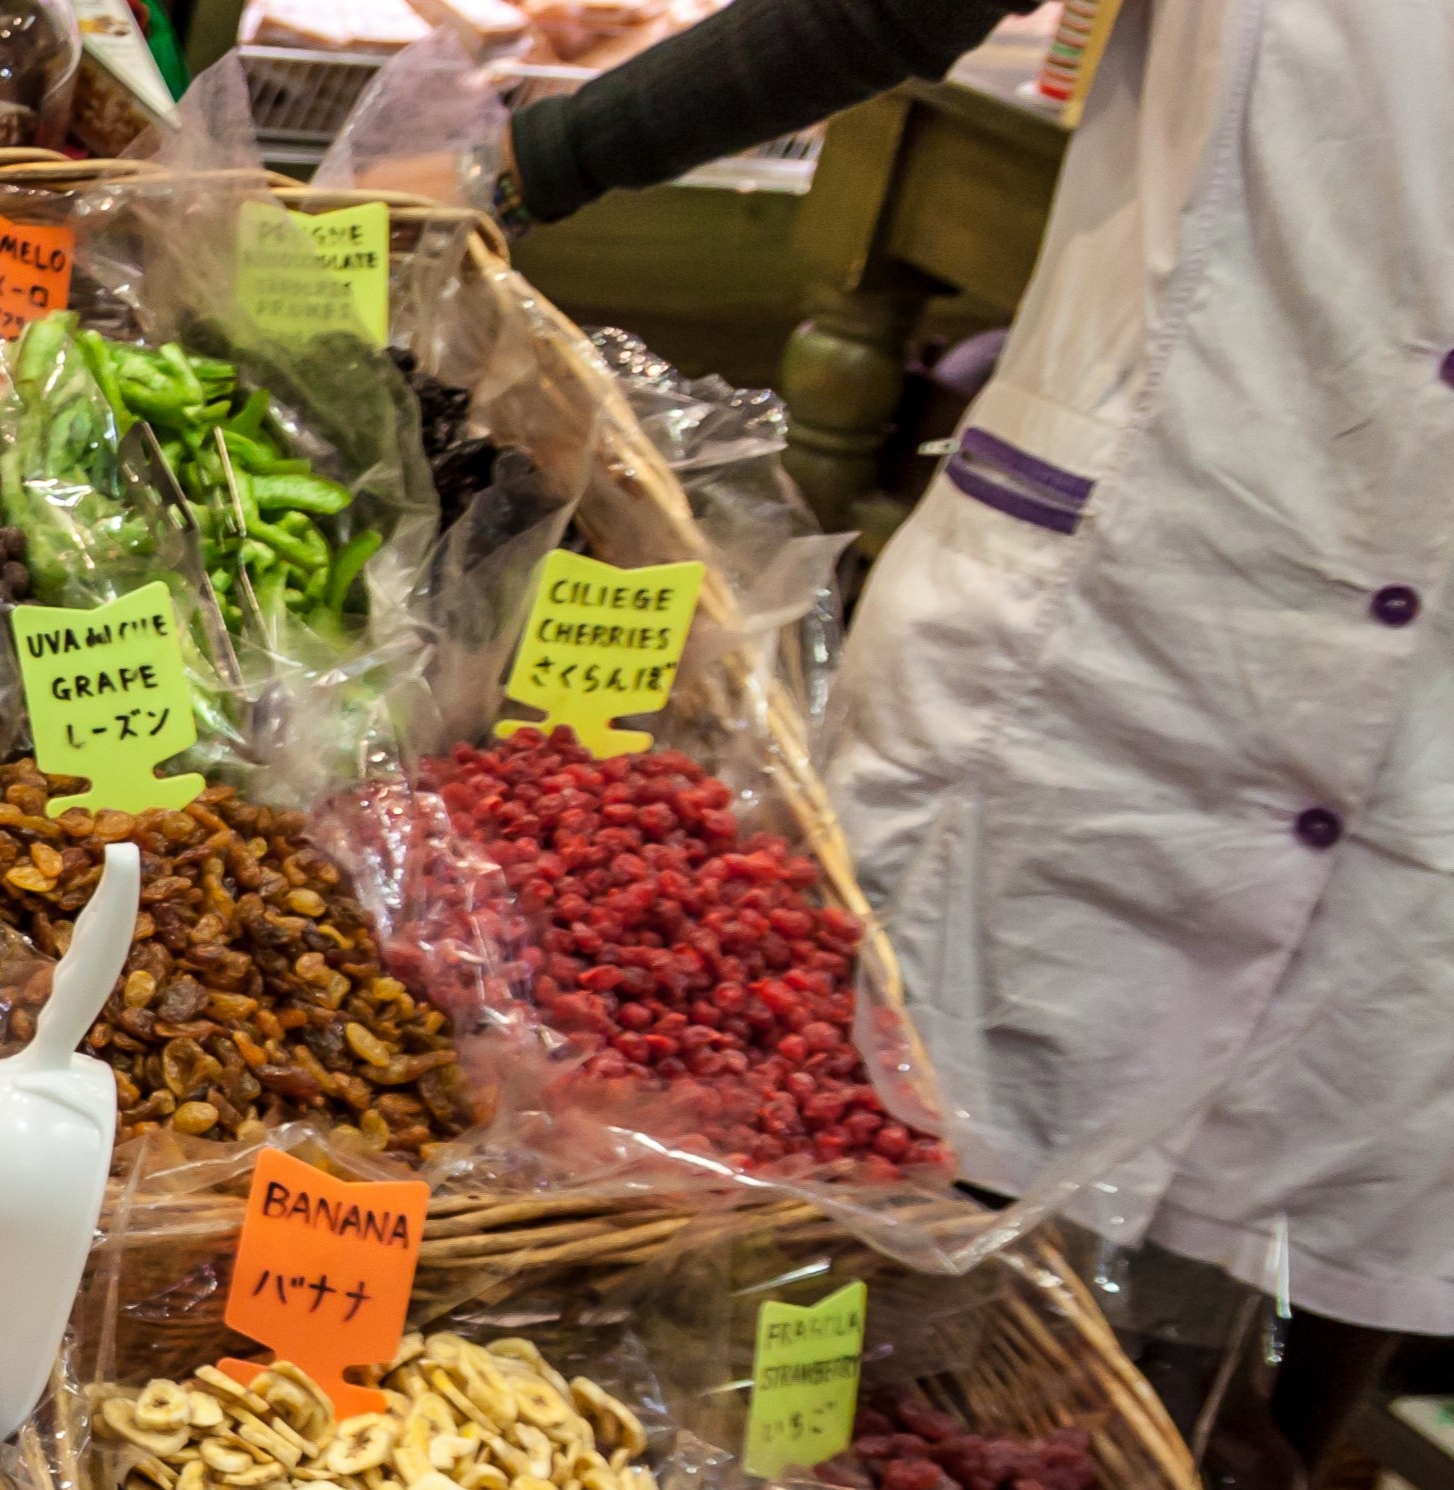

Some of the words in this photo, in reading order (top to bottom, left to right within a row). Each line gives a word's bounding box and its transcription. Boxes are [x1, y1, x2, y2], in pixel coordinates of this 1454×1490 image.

[550, 579, 675, 612] CILIEGE
[27, 628, 80, 658] UVA
[536, 618, 672, 650] CHERRIES
[52, 664, 159, 700] GRAPE
[67, 708, 171, 750] レーズン
[263, 1181, 411, 1249] BANANA
[252, 1270, 372, 1322] バナナ
